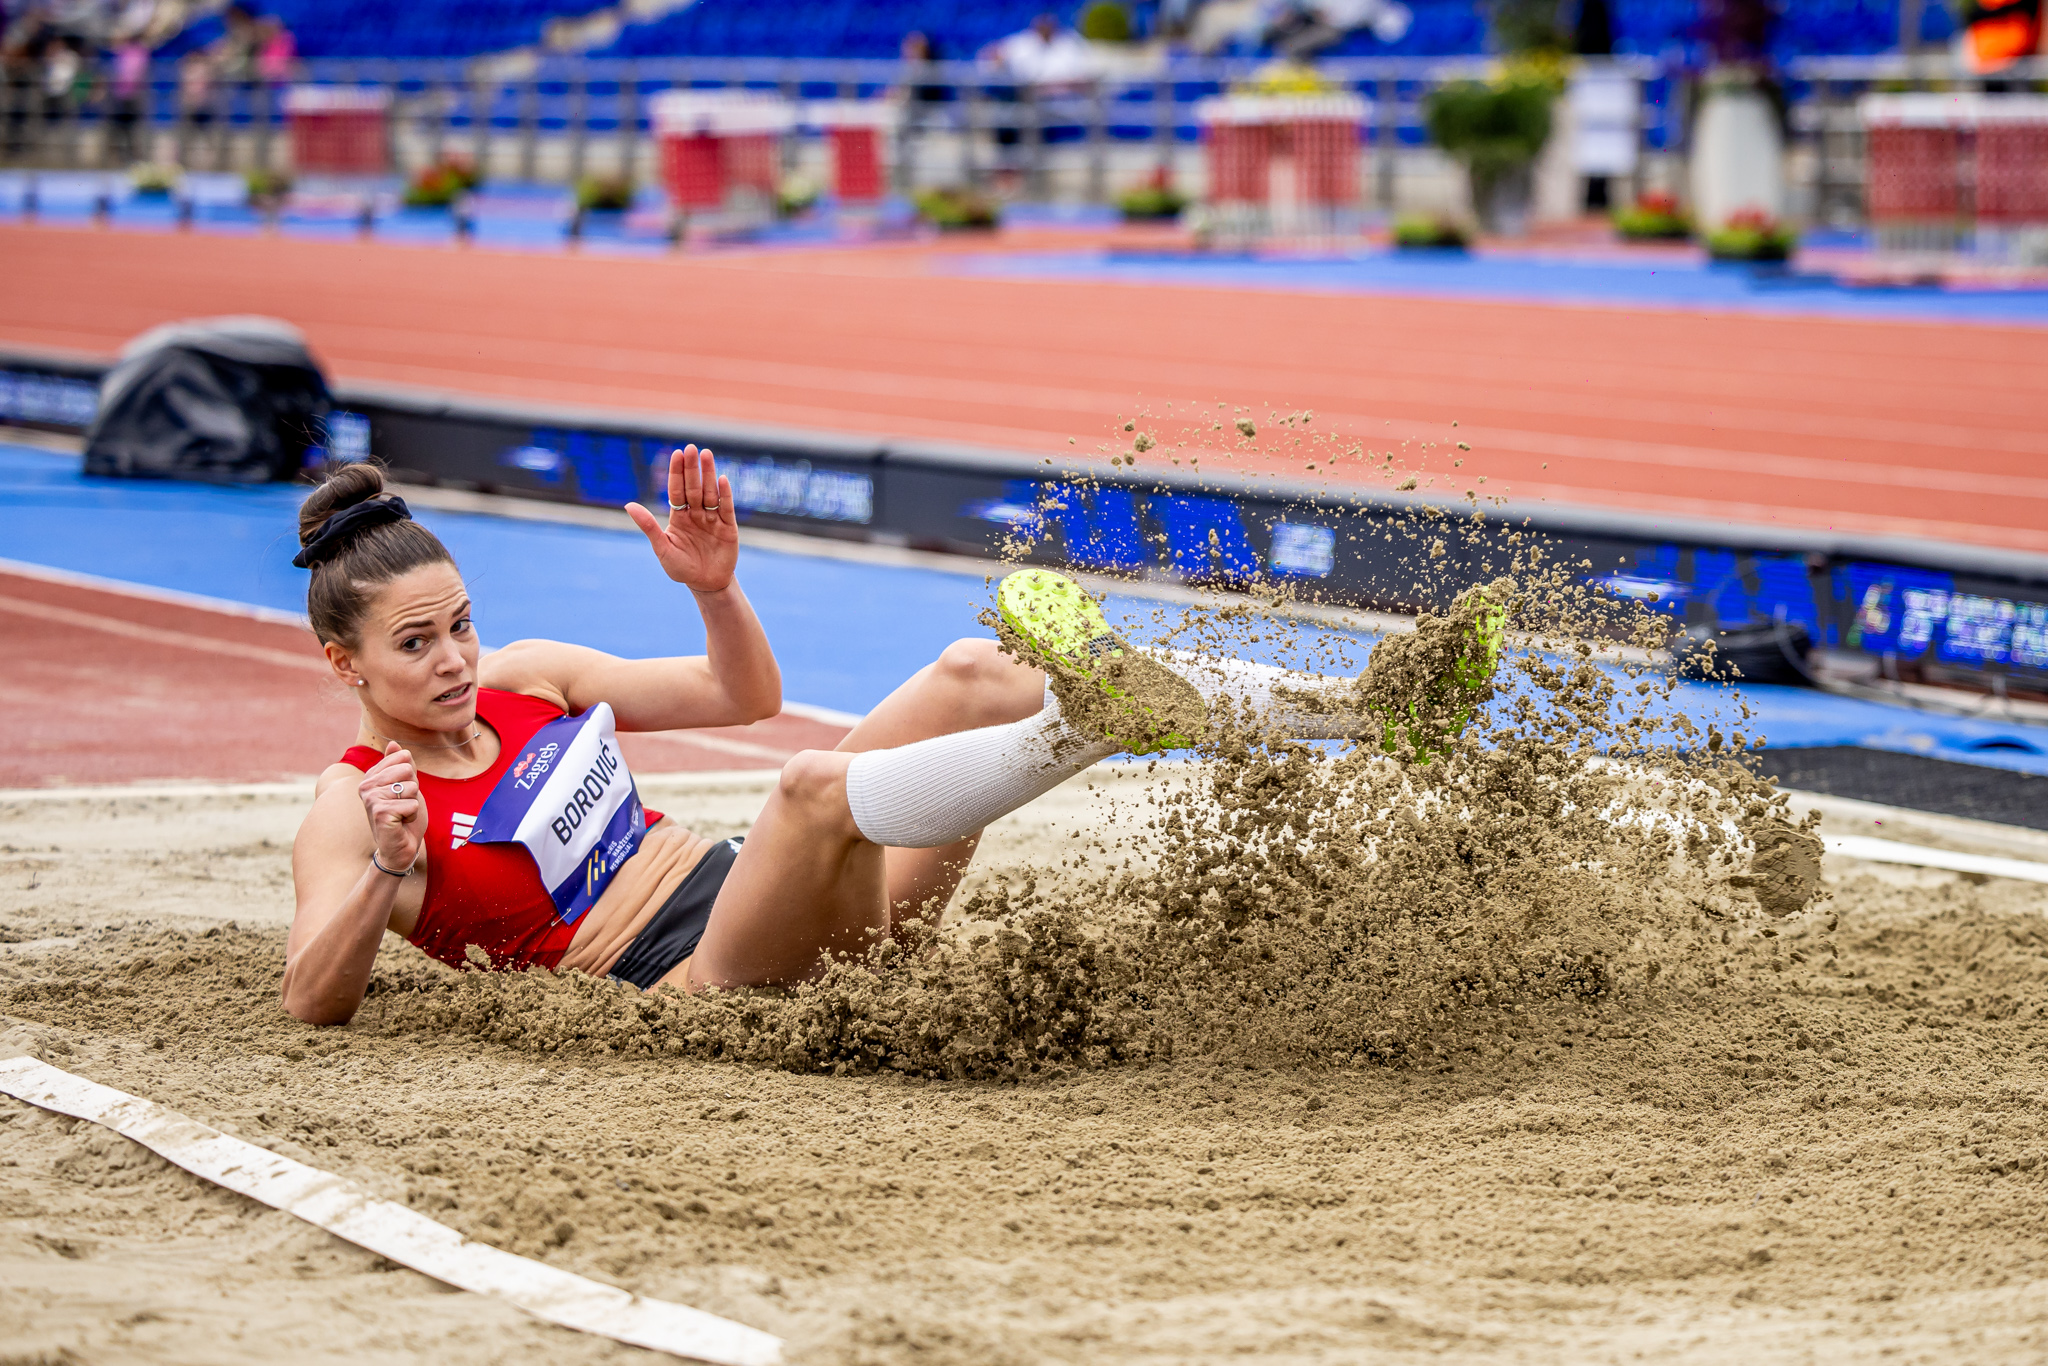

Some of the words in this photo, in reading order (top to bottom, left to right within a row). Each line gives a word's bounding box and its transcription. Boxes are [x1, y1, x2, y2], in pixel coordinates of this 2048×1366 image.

[514, 742, 559, 791] Zagreb
[551, 738, 618, 846] BOROVIĆ
[609, 842, 634, 872] MEMORIJAL
